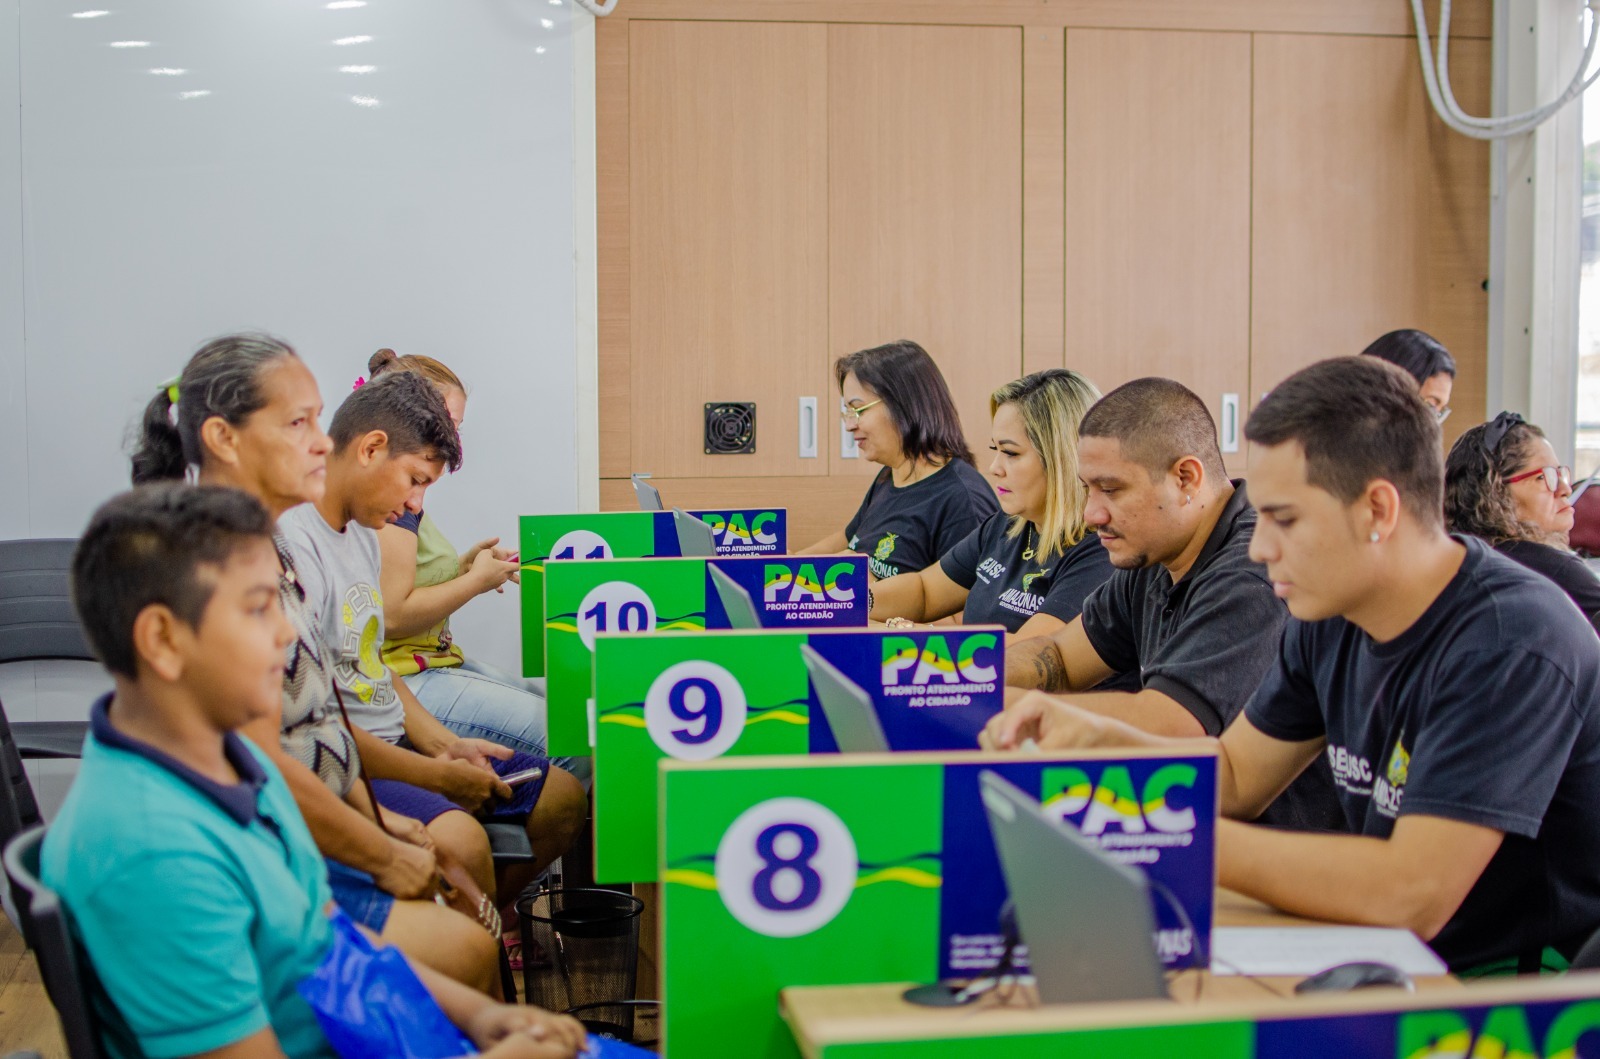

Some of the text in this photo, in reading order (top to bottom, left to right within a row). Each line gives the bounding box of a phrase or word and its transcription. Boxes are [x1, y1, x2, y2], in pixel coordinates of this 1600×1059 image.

[731, 544, 776, 552] ATENDIMENTO
[764, 562, 856, 602] PAC
[585, 601, 648, 632] 10
[766, 602, 853, 611] PRONTO ATENDIMENTO
[785, 610, 834, 620] AO CIDADÃO
[882, 633, 998, 685] PAC
[668, 677, 722, 745] 9
[1041, 763, 1198, 835] PAC
[752, 823, 821, 911] 8
